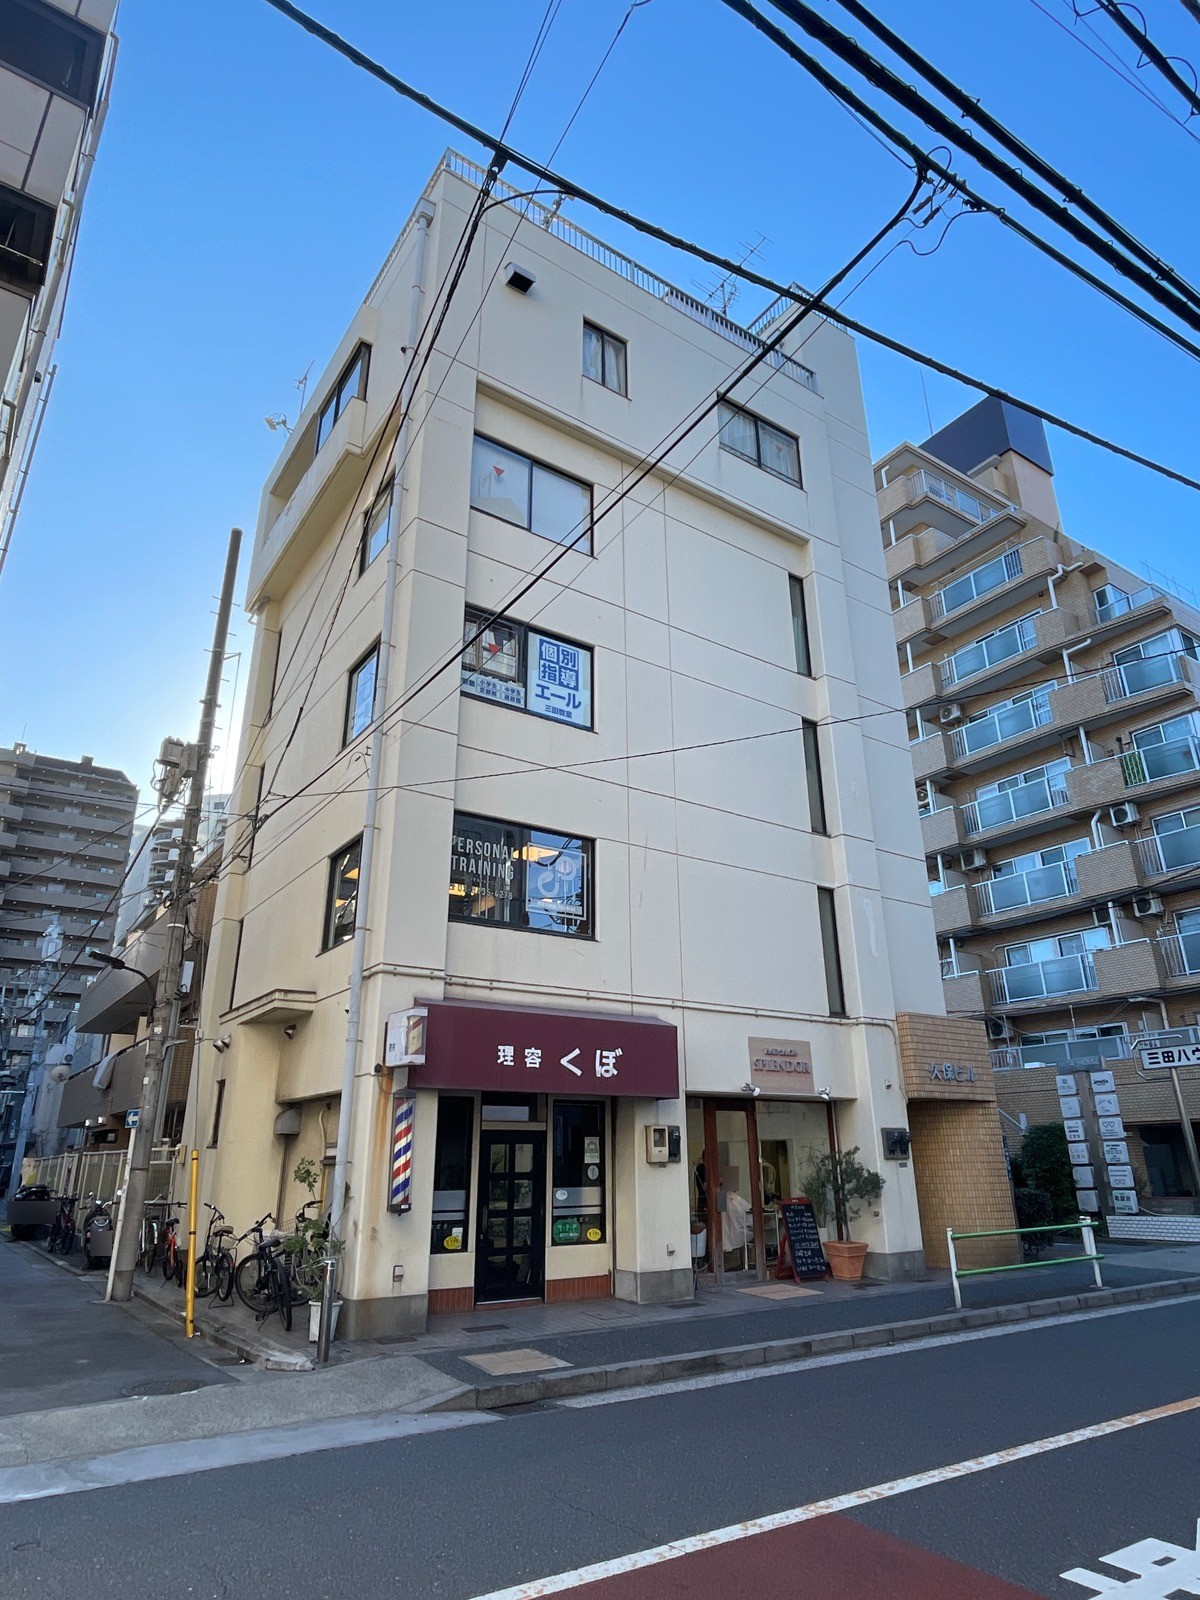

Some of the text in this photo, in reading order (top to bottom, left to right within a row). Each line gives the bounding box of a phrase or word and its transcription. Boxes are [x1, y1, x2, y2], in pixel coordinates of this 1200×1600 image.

[541, 642, 577, 668] 個別
[541, 662, 577, 688] 指導
[535, 683, 581, 709] エール
[545, 704, 573, 719] 三田教室
[451, 855, 514, 879] TRAINING
[497, 1046, 623, 1078] 理容くぼ
[754, 1059, 811, 1074] SPLENDOR
